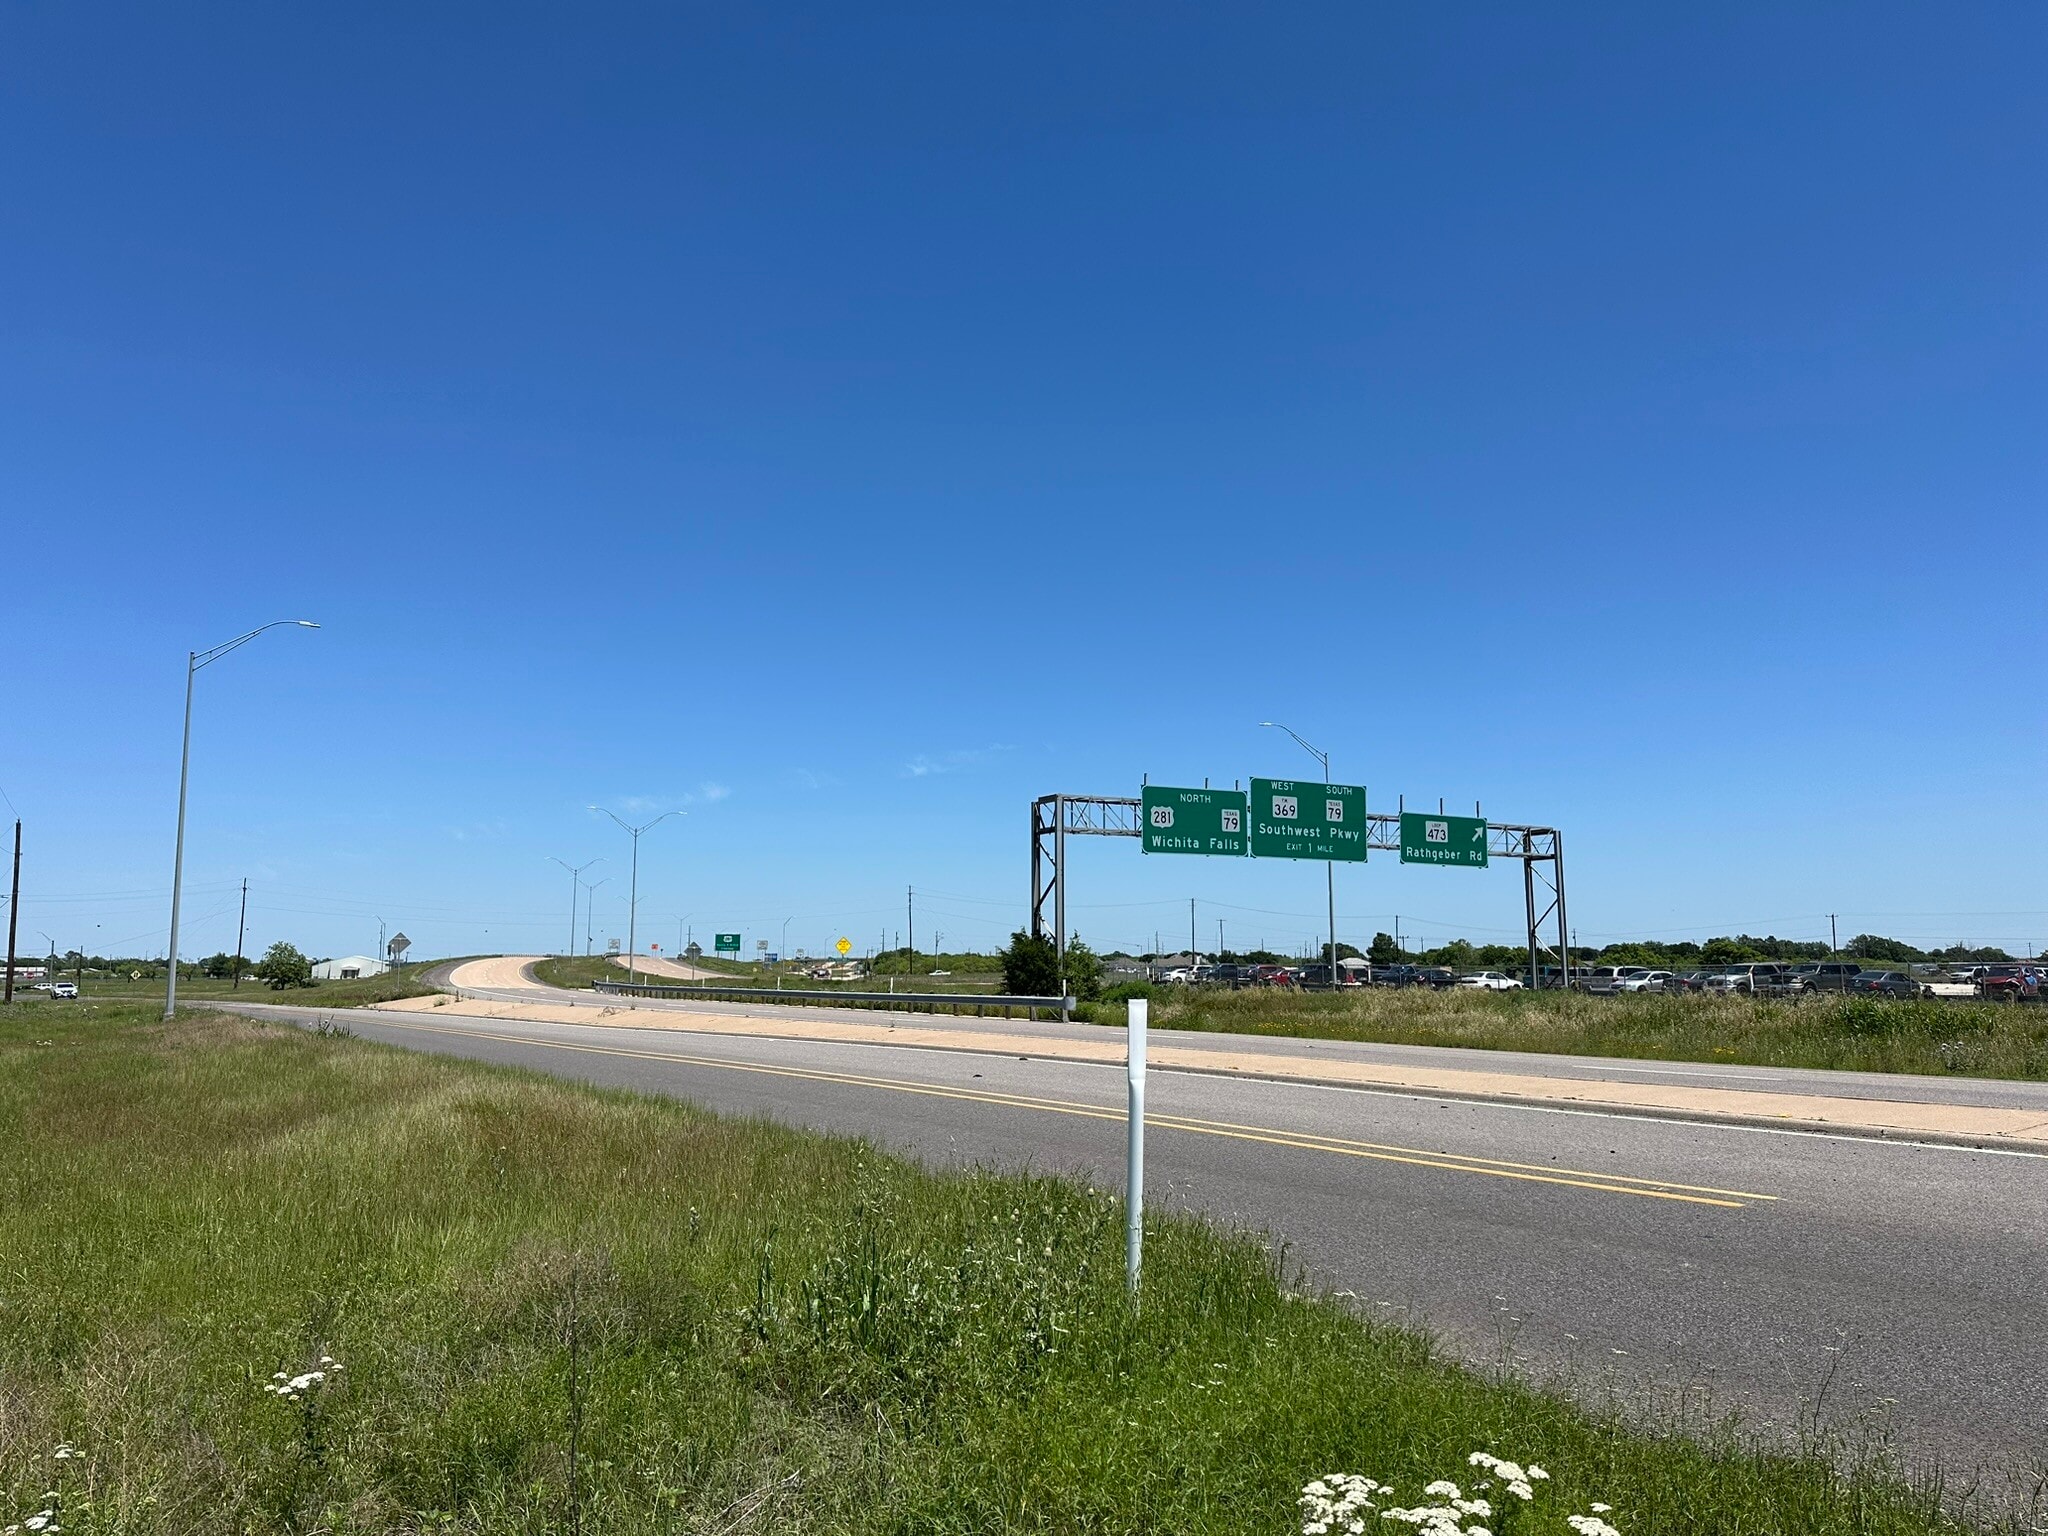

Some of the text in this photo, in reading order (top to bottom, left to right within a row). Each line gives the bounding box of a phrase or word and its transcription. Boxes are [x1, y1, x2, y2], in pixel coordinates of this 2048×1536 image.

[1271, 781, 1294, 791] WEST
[1326, 786, 1353, 795] SOUTH
[1180, 793, 1211, 803] NORTH
[1274, 804, 1296, 817] 369
[1328, 807, 1341, 819] 79
[1154, 811, 1171, 824] 281
[1223, 817, 1238, 830] 79
[1259, 823, 1359, 842] Southwest Pkwy
[1427, 829, 1446, 841] 473
[1152, 835, 1239, 850] Wichita Falls
[1286, 842, 1333, 853] EXIT 1 MILE
[1406, 846, 1482, 862] Rathgeber Rd
